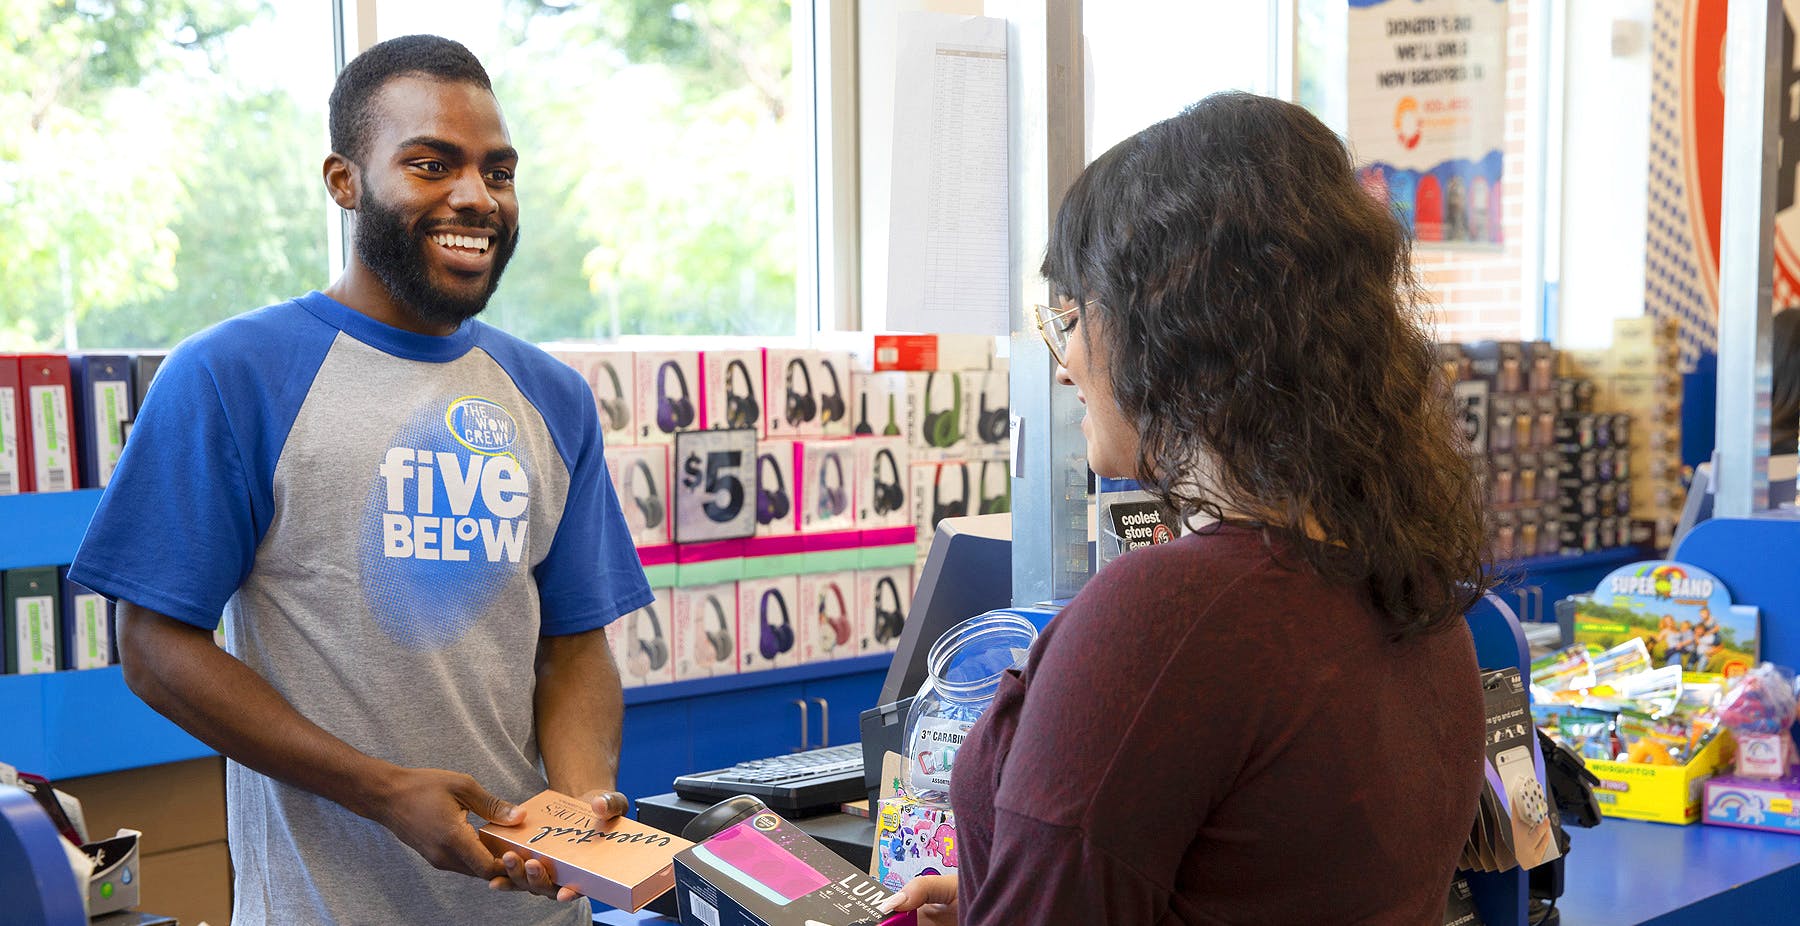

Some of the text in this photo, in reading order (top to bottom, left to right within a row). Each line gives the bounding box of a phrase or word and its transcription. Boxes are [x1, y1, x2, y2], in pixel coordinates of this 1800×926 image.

[463, 404, 487, 418] THE
[476, 416, 509, 434] WOW
[465, 429, 509, 446] CREW!
[380, 447, 529, 519] five
[683, 450, 744, 522] $5
[1122, 510, 1160, 526] coolest
[383, 513, 528, 562] BELOW
[1125, 526, 1152, 539] store
[1611, 575, 1713, 598] SUPER BAND
[1502, 712, 1511, 720] and
[1511, 708, 1524, 717] stand
[528, 825, 671, 847] essential
[830, 884, 849, 896] LIGHT
[856, 900, 882, 920] SPEAKER
